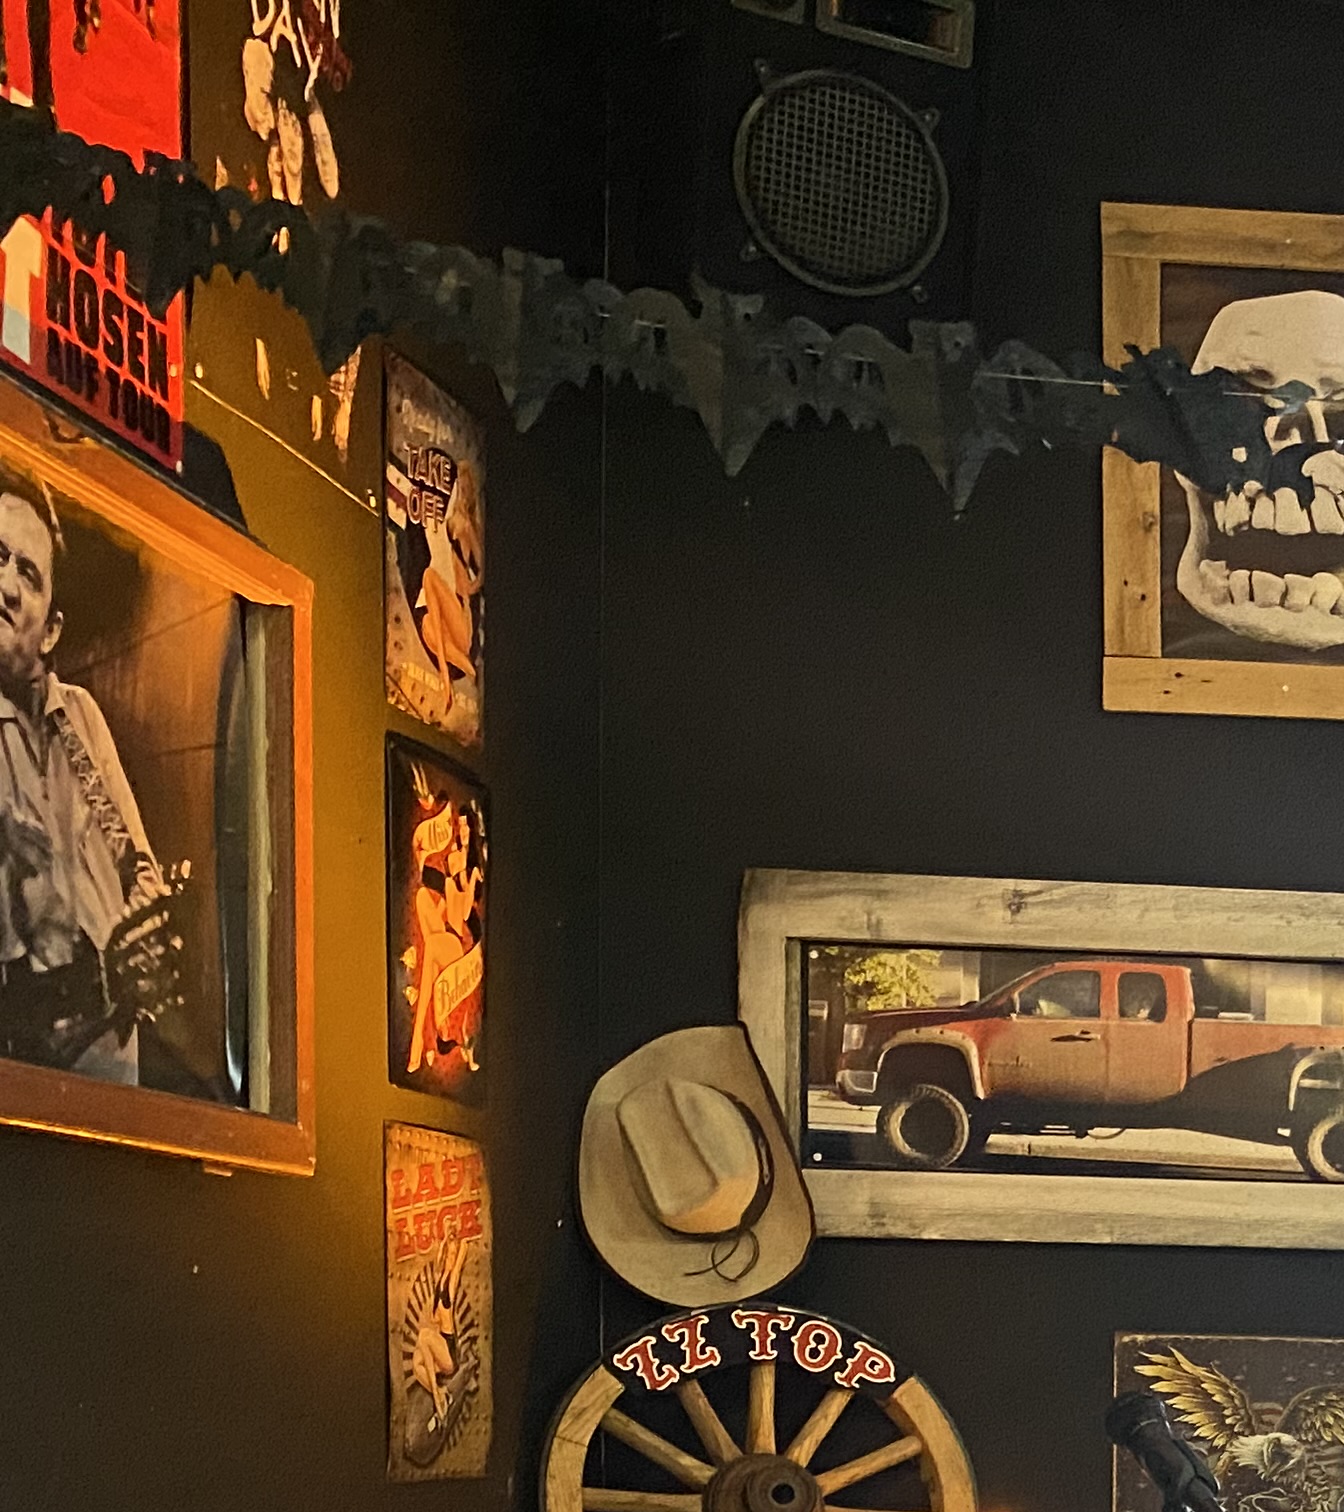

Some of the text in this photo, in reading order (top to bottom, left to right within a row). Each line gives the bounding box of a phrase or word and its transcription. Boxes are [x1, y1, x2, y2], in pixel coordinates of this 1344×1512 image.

[46, 246, 169, 401] HOSEN
[403, 441, 451, 495] TAKE
[407, 486, 444, 534] OFF
[613, 1309, 896, 1391] ZZ TOP
